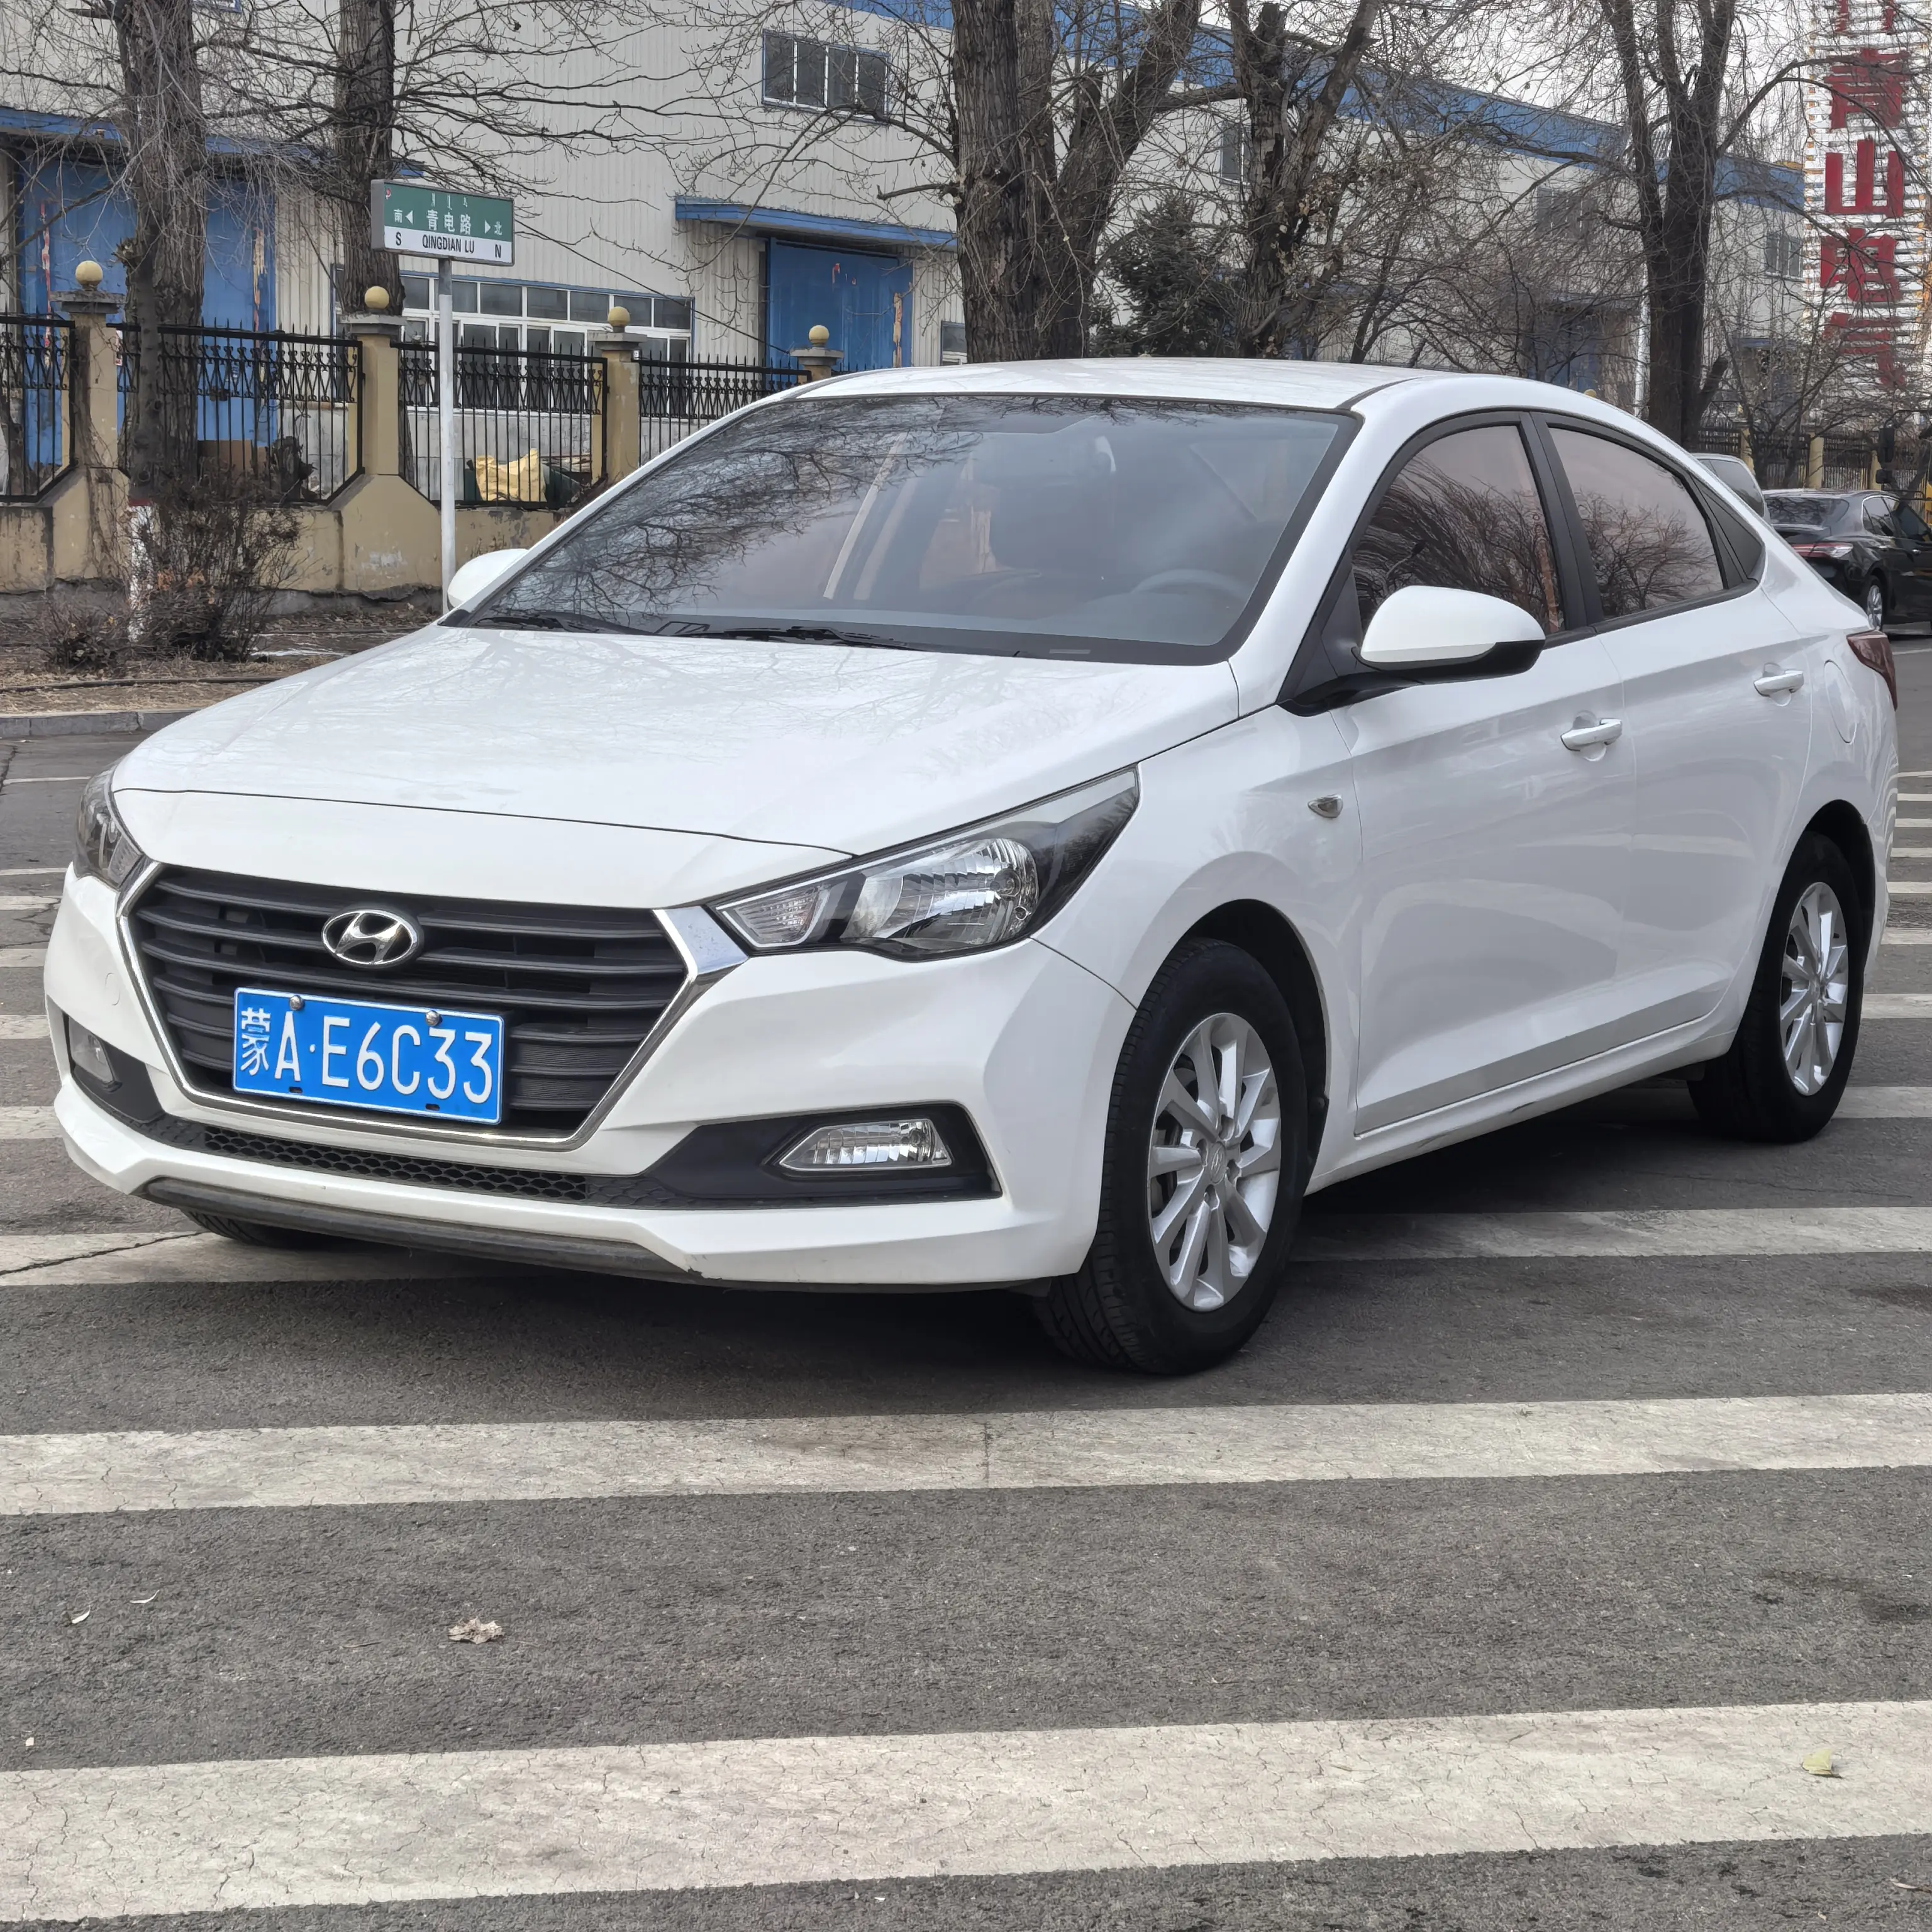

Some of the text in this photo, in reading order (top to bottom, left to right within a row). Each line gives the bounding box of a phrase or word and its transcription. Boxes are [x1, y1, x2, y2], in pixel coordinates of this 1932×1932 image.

[393, 209, 502, 236] 南 青电路 北
[1819, 0, 1909, 390] 青山电气
[396, 231, 501, 258] S QINGDIAN LU N
[240, 1006, 494, 1104] 蒙A·E6C33
